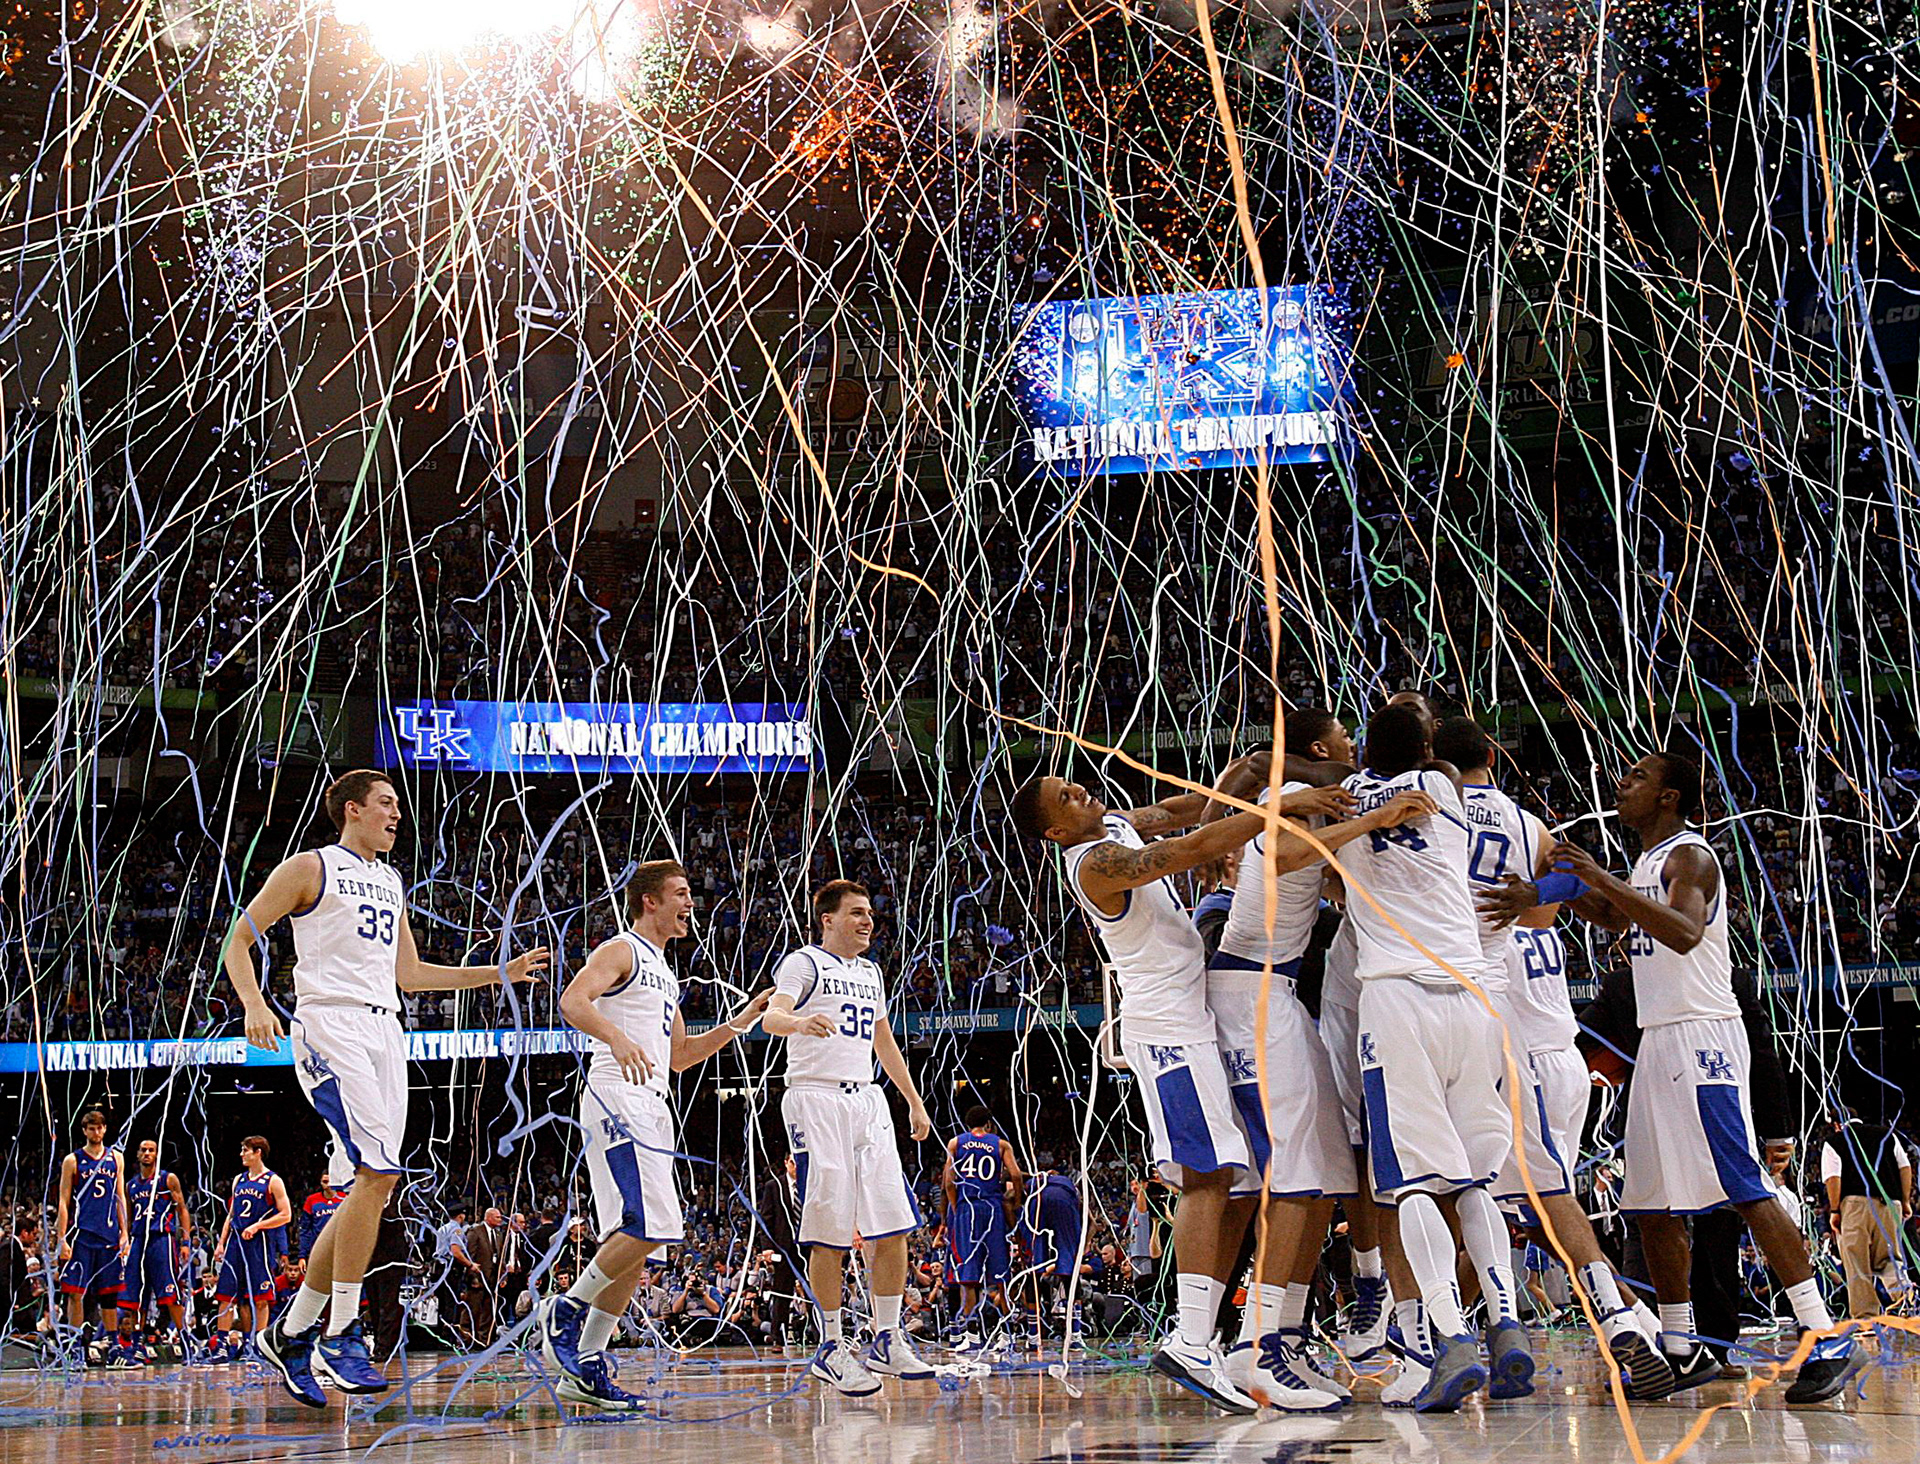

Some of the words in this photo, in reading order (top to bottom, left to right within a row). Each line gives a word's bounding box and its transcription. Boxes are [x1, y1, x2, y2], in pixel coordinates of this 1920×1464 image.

[1032, 416, 1169, 462] NATIONAL
[1179, 411, 1337, 452] CHAMPIONS
[395, 706, 471, 761] UK
[510, 719, 641, 757] NATIONAL
[650, 720, 812, 757] CHAMPIONS
[357, 904, 394, 946] 33
[1515, 929, 1562, 980] 20
[661, 1001, 674, 1037] 5
[839, 1003, 875, 1040] 32
[46, 1042, 147, 1072] NATIONAL
[1224, 1049, 1257, 1081] UK
[1695, 1050, 1736, 1081] UK
[962, 1141, 995, 1154] YOUNG
[960, 1153, 996, 1181] 40
[93, 1180, 106, 1198] 5
[234, 1188, 264, 1200] KANSAS
[239, 1200, 252, 1218] 2
